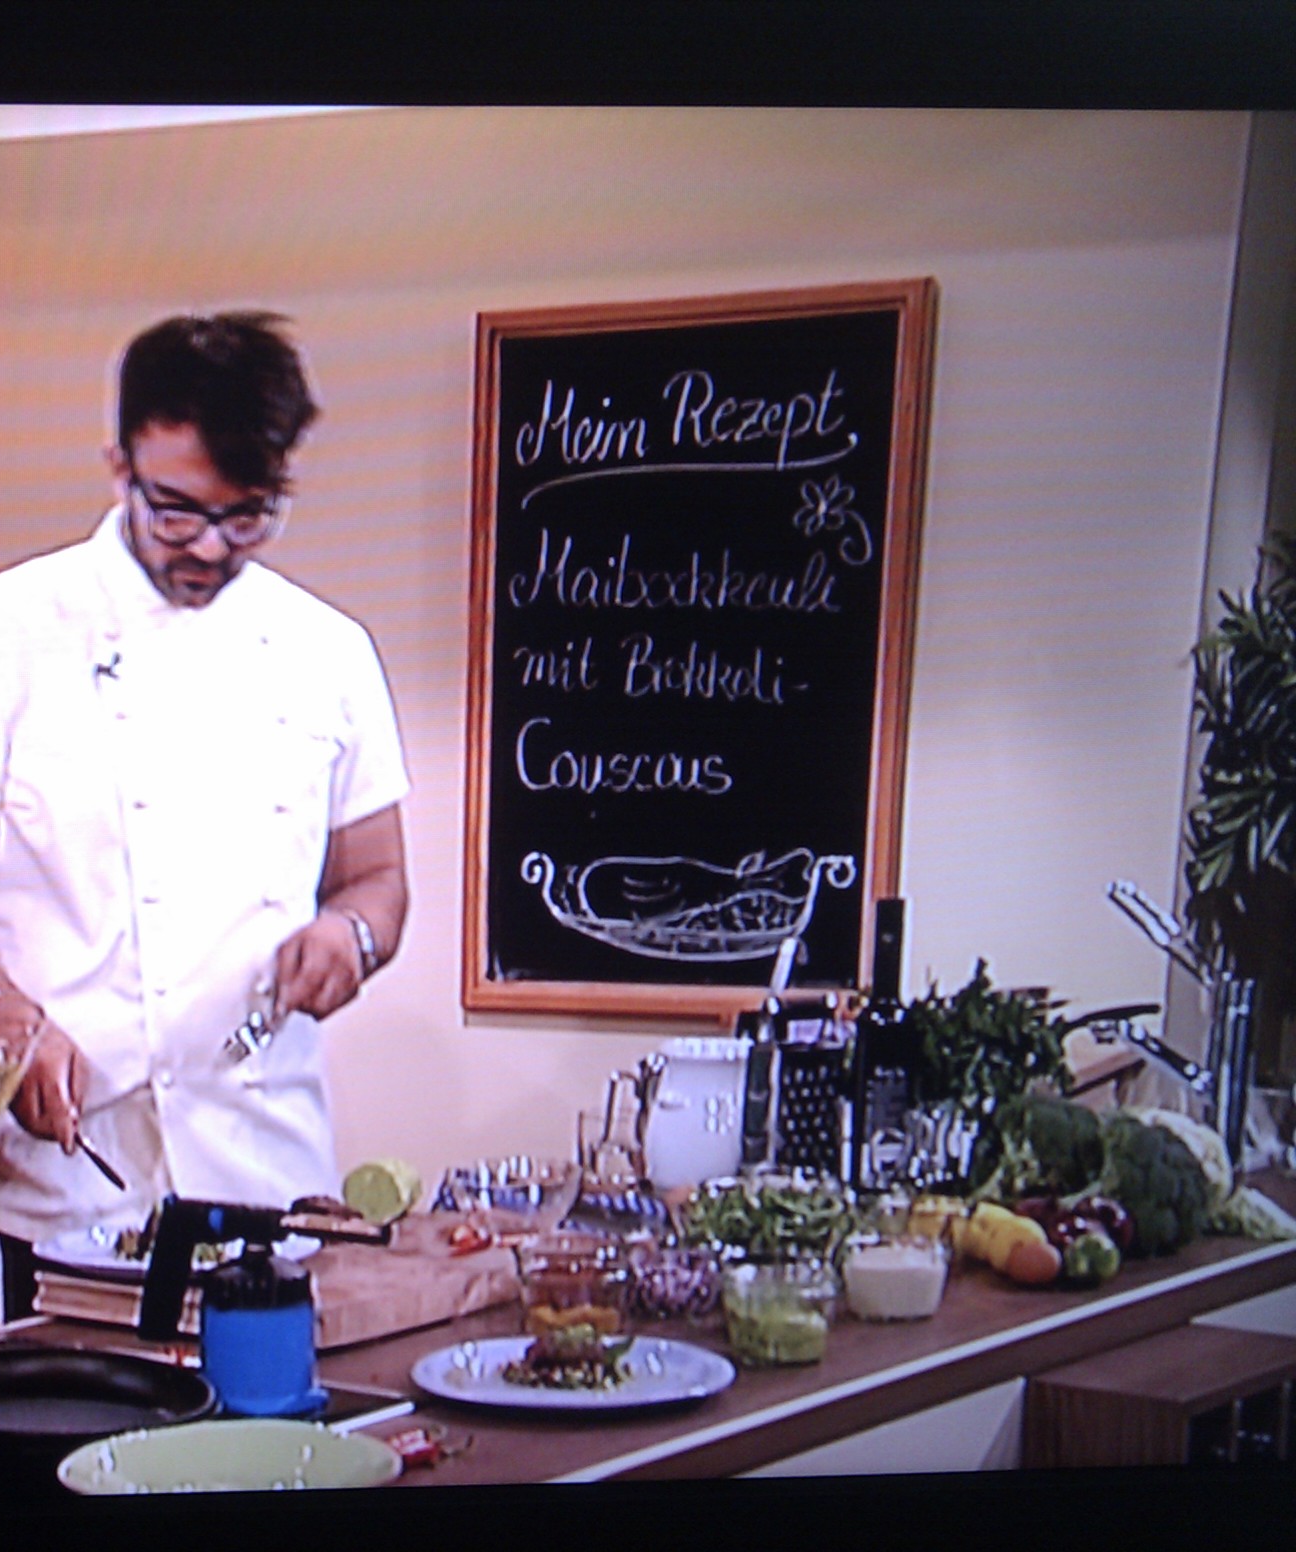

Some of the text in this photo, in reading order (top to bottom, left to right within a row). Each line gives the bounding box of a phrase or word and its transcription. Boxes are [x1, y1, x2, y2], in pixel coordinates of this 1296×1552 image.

[516, 368, 845, 471] Mein Rezept
[509, 527, 841, 613] Maibockkeule
[514, 637, 598, 692] mit
[516, 717, 733, 794] Couscous
